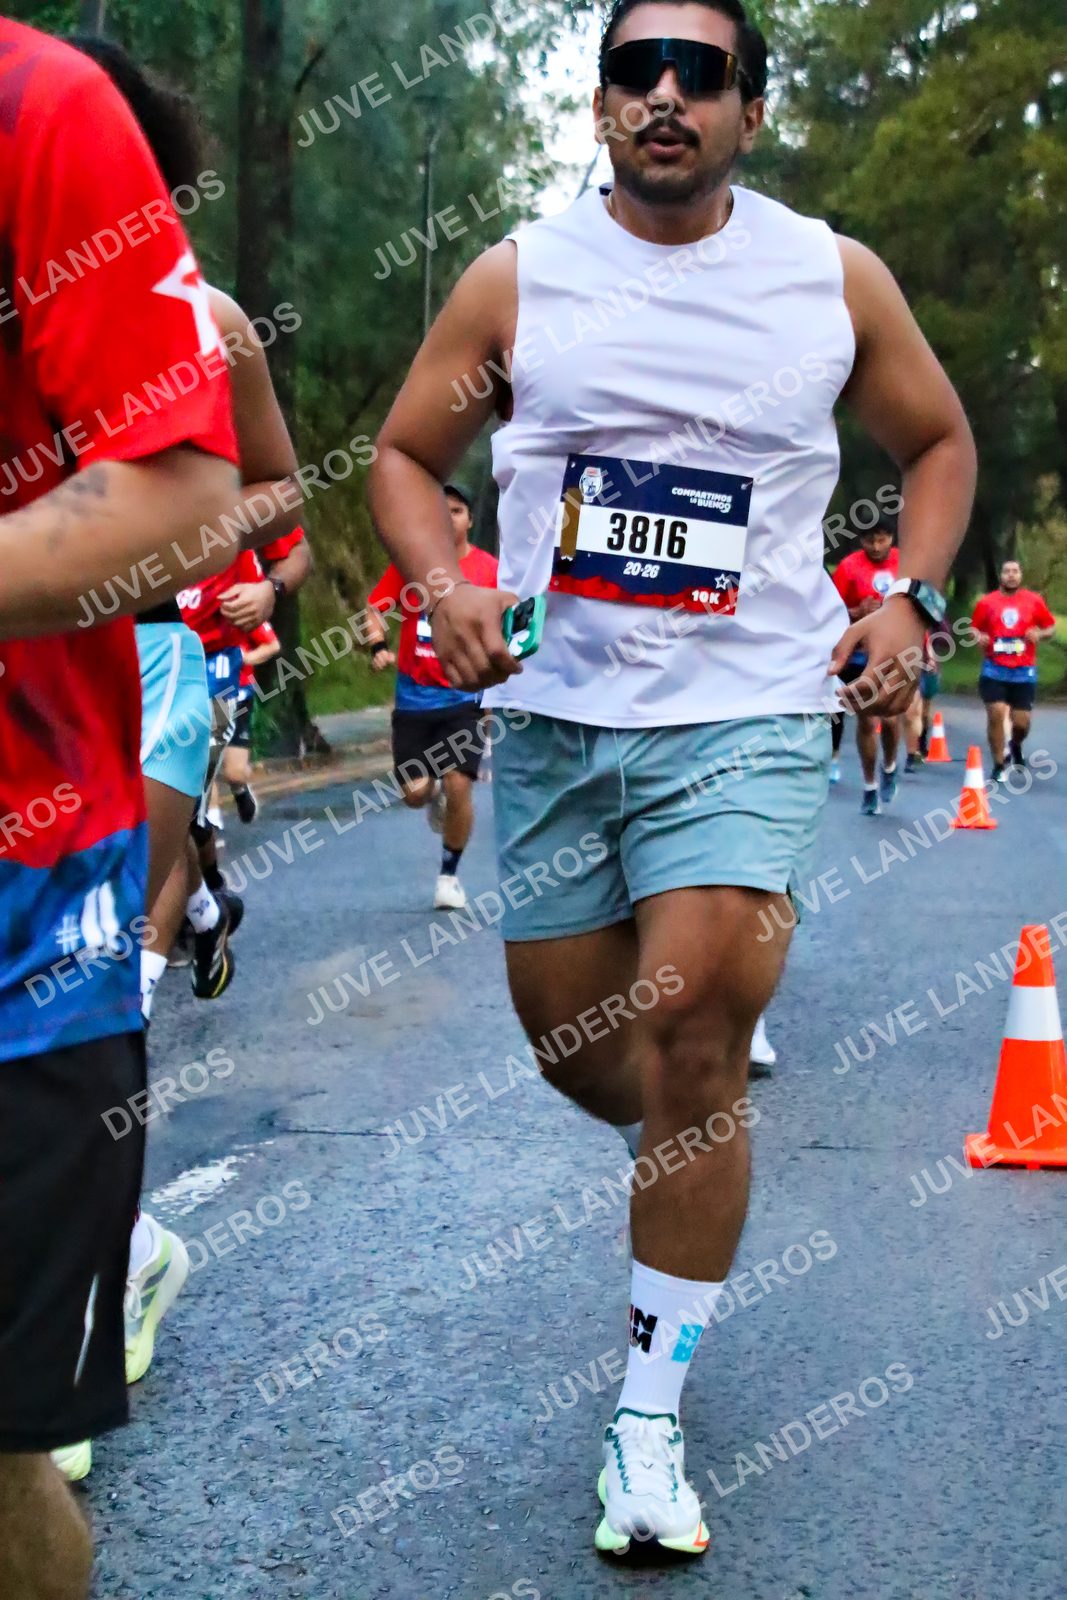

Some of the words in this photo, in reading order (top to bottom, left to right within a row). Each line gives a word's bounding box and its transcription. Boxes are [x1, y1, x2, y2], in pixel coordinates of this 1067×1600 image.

[672, 487, 732, 503] COMPARTIMOS
[607, 512, 688, 560] 3816
[691, 590, 720, 605] 10K
